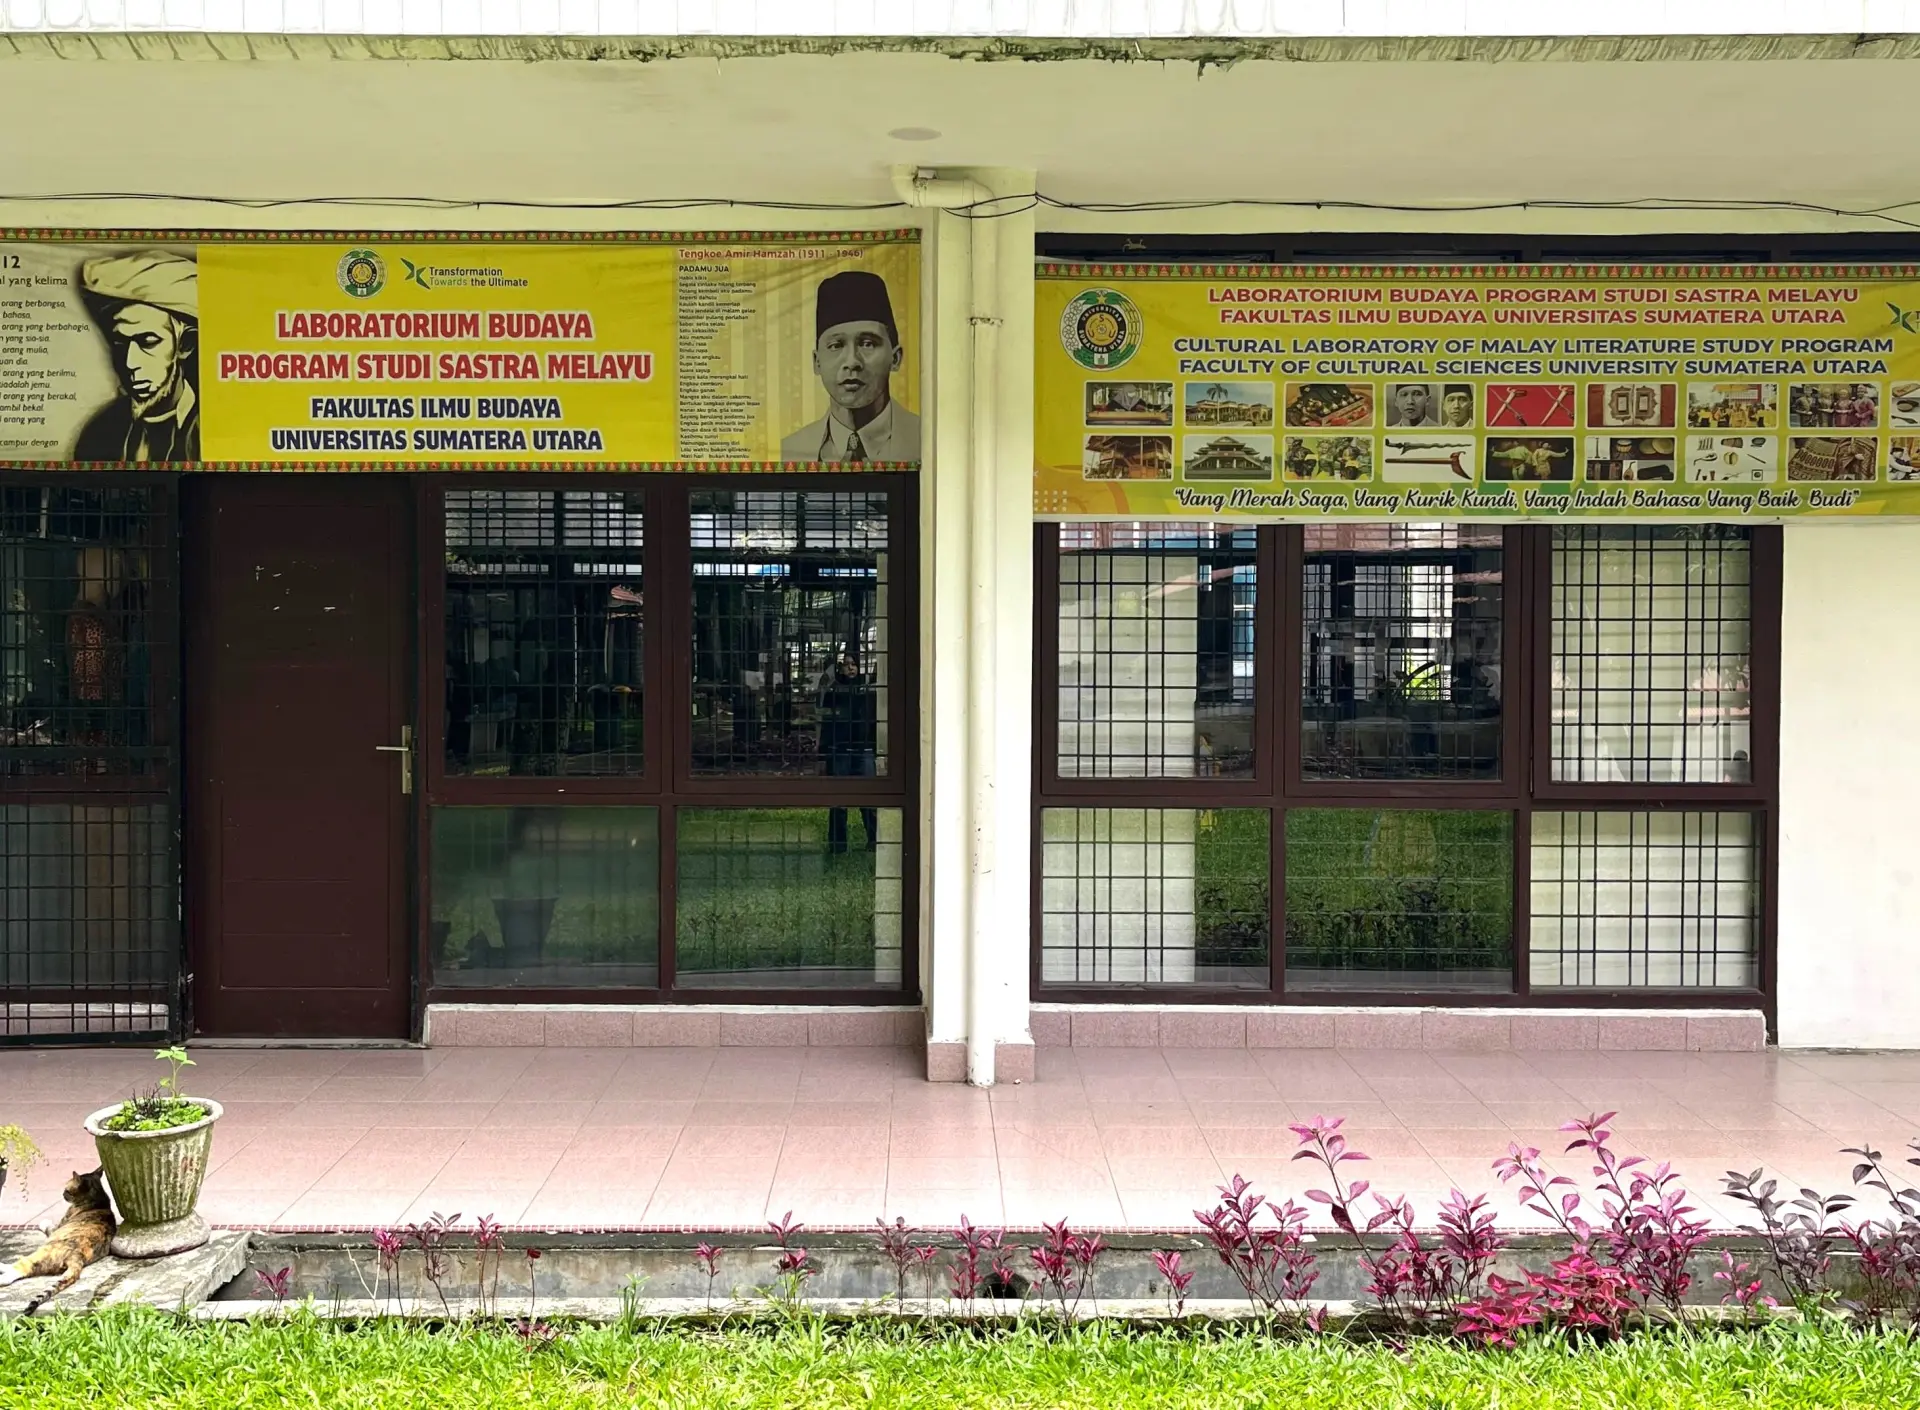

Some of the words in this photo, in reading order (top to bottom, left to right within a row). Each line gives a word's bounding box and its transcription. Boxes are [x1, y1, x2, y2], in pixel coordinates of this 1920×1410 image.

[679, 249, 721, 260] Tengkoe
[725, 249, 751, 258] Amir
[754, 250, 795, 258] Hamzah
[799, 249, 825, 259] (1911
[837, 248, 863, 259] 1946)
[4, 256, 20, 268] 12
[430, 267, 503, 276] Transformation
[9, 278, 31, 287] yang
[35, 276, 67, 285] kelima
[430, 277, 467, 286] Towards
[470, 277, 485, 286] the
[488, 277, 528, 286] Ultimate
[1210, 289, 1381, 302] LABORATORIUM
[1390, 289, 1478, 302] BUDAYA
[1487, 290, 1596, 302] PROGRAM
[1604, 289, 1666, 302] STUDI
[1675, 290, 1761, 302] SASTRA
[1769, 289, 1857, 302] MELAYU
[3, 311, 31, 319] bahasa,
[1222, 310, 1330, 323] FAKULTAS
[1339, 310, 1390, 323] ILMU
[1399, 310, 1486, 323] BUDAYA
[1495, 310, 1636, 323] UNIVERSITAS
[1644, 310, 1764, 323] SUMATERA
[1772, 310, 1845, 323] UTARA
[279, 314, 479, 338] LABORATORIUM
[489, 314, 592, 338] BUDAYA
[2, 347, 24, 355] orang
[1174, 339, 1285, 352] CULTURAL
[1294, 340, 1438, 353] LABORATORY
[1446, 340, 1474, 352] OF
[1482, 340, 1557, 353] MALAY
[1565, 340, 1695, 353] LITERATURE
[1703, 340, 1774, 353] STUDY
[1782, 339, 1892, 352] PROGRAM
[221, 354, 348, 378] PROGRAM
[358, 354, 430, 378] STUDI
[440, 354, 539, 378] SASTRA
[548, 355, 650, 379] MELAYU
[1181, 360, 1274, 372] FACULTY
[1282, 361, 1310, 373] OF
[1317, 361, 1428, 374] CULTURAL
[1436, 360, 1541, 374] SCIENCES
[1550, 361, 1678, 374] UNIVERSITY
[1685, 360, 1805, 374] SUMATERA
[1814, 360, 1887, 373] UTARA
[312, 398, 414, 418] FAKULTAS
[422, 398, 470, 418] ILMU
[478, 399, 561, 418] BUDAYA
[31, 439, 58, 448] dengan
[272, 430, 406, 450] UNIVERSITAS
[414, 430, 526, 450] SUMATERA
[533, 431, 602, 450] UTARA
[1230, 490, 1293, 506] Merah
[1300, 490, 1347, 512] Saga,
[1355, 490, 1398, 512] Yang
[1405, 490, 1455, 506] Kurik
[1462, 490, 1518, 511] Kundi,
[1525, 490, 1568, 512] Yang
[1576, 488, 1626, 506] Indah
[1633, 490, 1701, 506] Bahasa
[1708, 490, 1754, 512] Yang
[1758, 489, 1799, 507] Baik
